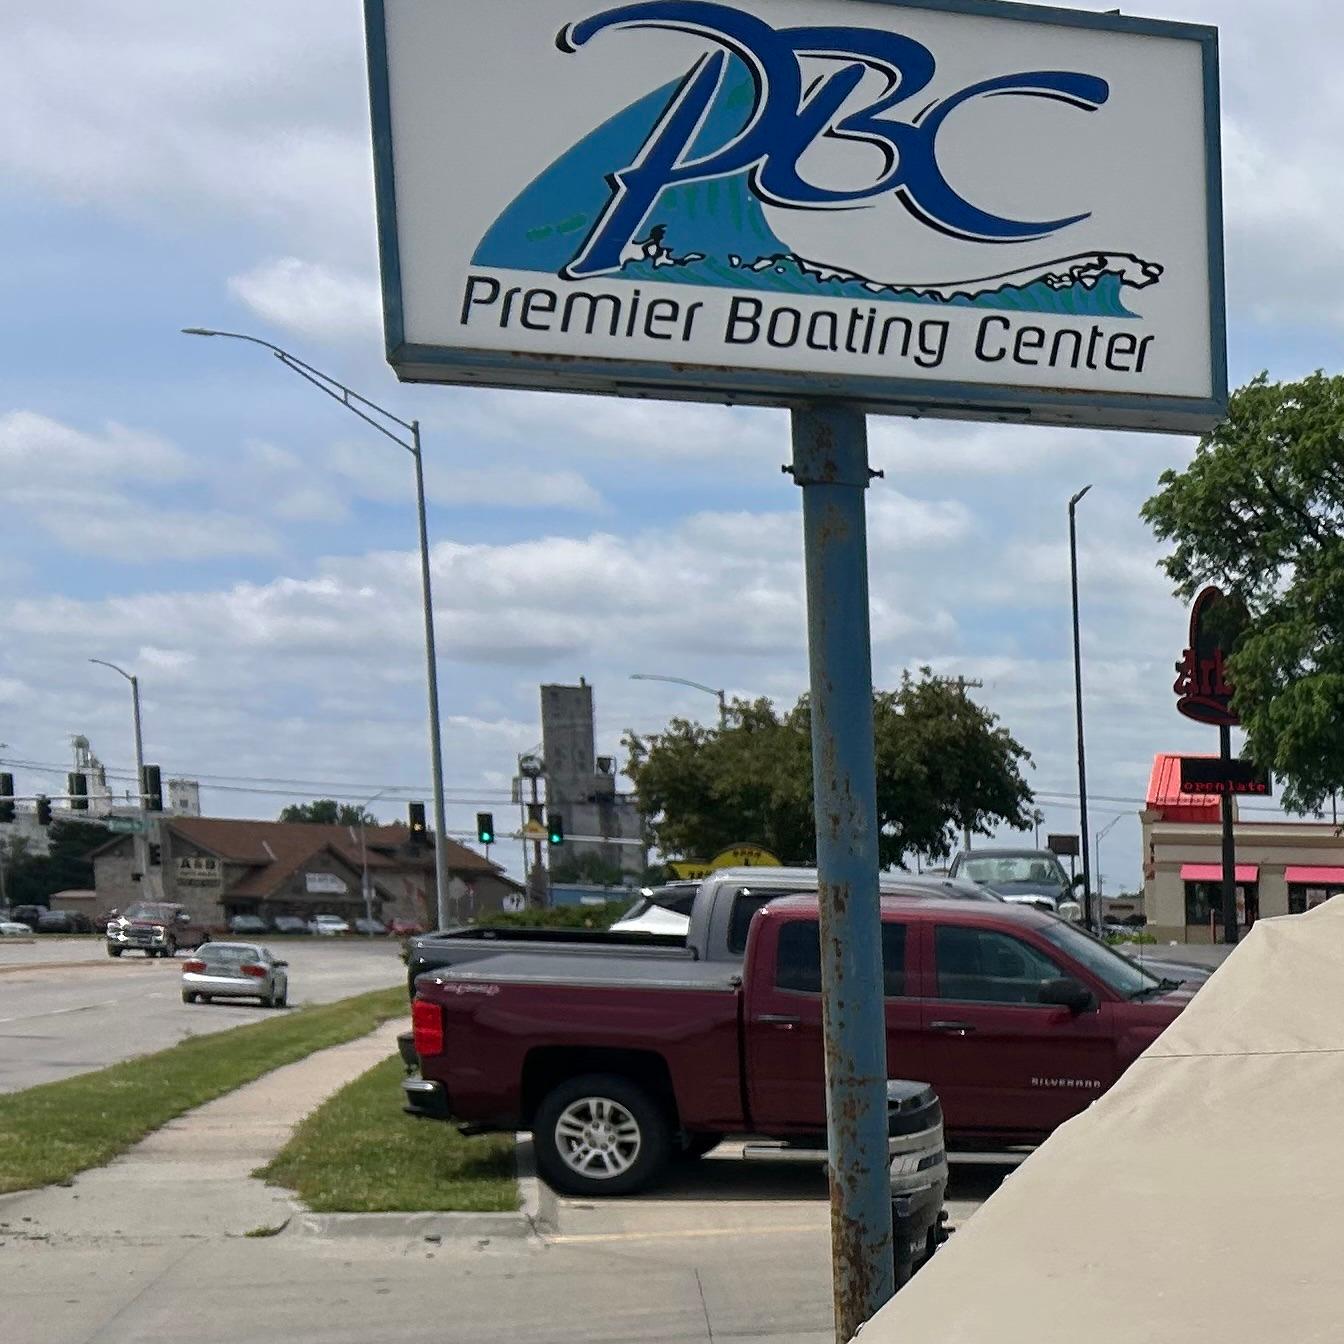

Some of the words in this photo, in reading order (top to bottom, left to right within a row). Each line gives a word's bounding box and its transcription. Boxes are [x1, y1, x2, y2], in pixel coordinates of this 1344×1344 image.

[555, 0, 1110, 280] PBC
[459, 274, 704, 342] Premier
[723, 295, 950, 369] Boating
[974, 314, 1156, 374] Center
